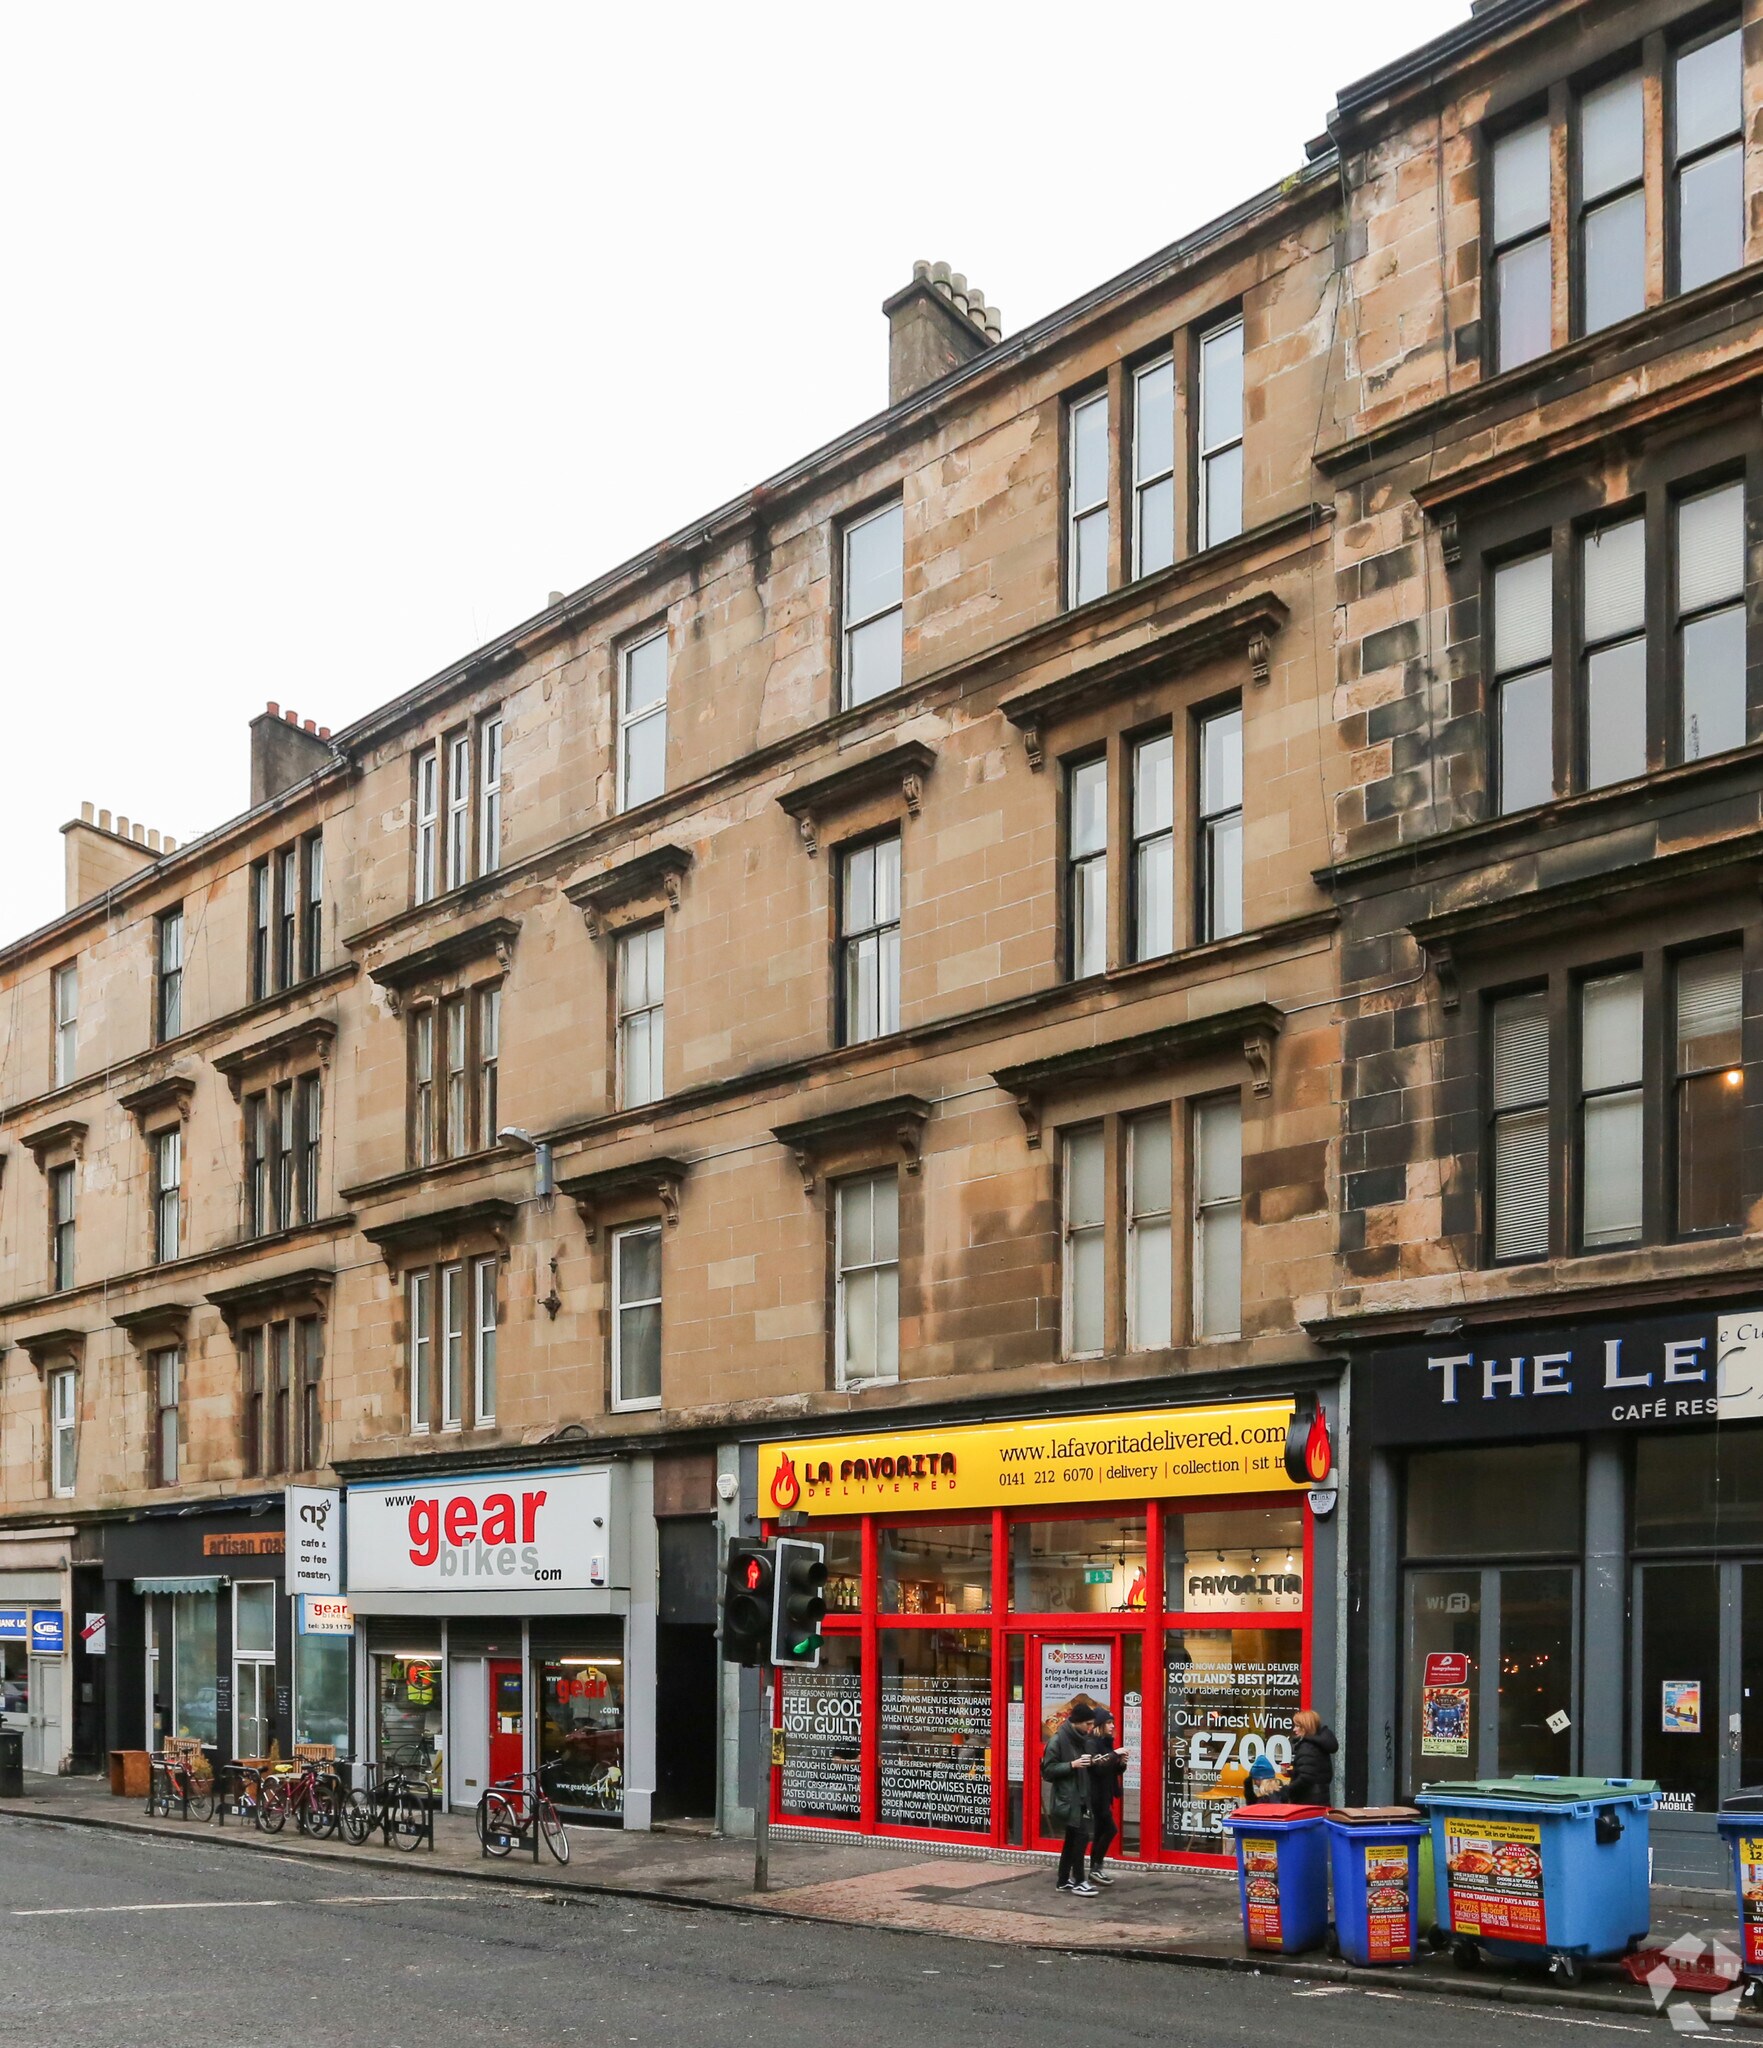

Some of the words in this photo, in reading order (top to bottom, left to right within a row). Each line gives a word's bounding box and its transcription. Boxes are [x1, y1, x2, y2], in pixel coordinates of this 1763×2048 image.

[1428, 1351, 1572, 1403] THE
[1603, 1338, 1706, 1388] LE
[1612, 1398, 1666, 1420] CAFÉ
[1676, 1398, 1718, 1416] RES
[1000, 1425, 1287, 1463] www.lafavoritadelivered.com
[806, 1462, 832, 1485] LA
[840, 1452, 956, 1482] FAVORITA
[1000, 1473, 1024, 1486] 0141
[1034, 1470, 1055, 1484] 212
[1063, 1468, 1094, 1482] 6070
[1106, 1464, 1158, 1481] delivery
[1172, 1459, 1239, 1476] collection
[1252, 1456, 1270, 1470] sit
[808, 1480, 956, 1498] DELIVERED
[385, 1496, 416, 1507] www
[408, 1490, 548, 1566] gear
[210, 1536, 254, 1554] artisan
[302, 1540, 320, 1548] cafe
[300, 1556, 327, 1564] cofee
[440, 1539, 539, 1576] bikes
[534, 1568, 562, 1580] com
[1189, 1574, 1302, 1596] FAVORITA
[1194, 1597, 1300, 1606] LIVERED
[314, 1603, 347, 1616] gear
[0, 1619, 15, 1627] ANK
[1067, 1668, 1082, 1676] large
[1169, 1662, 1194, 1670] ORDER
[1234, 1663, 1246, 1671] WE
[1247, 1663, 1266, 1671] WILL
[1268, 1663, 1299, 1671] DELIVER
[924, 1681, 949, 1689] TWO
[1169, 1672, 1236, 1684] SCOTLAND'S
[1238, 1674, 1265, 1684] BEST
[1266, 1674, 1300, 1685] PIZZA
[557, 1680, 607, 1704] gear
[1169, 1686, 1177, 1694] to
[1178, 1687, 1197, 1696] your
[1199, 1686, 1219, 1695] table
[1221, 1687, 1240, 1696] here
[1251, 1690, 1271, 1698] your
[1273, 1688, 1299, 1698] home
[782, 1698, 814, 1715] FEEL
[816, 1698, 862, 1717] GOOD
[899, 1695, 920, 1703] DRINKS
[922, 1696, 940, 1704] MENU
[949, 1697, 991, 1705] RESTAURANT
[782, 1715, 813, 1733] NOT
[814, 1716, 862, 1735] GUILTY
[882, 1716, 902, 1724] WHEN
[915, 1717, 927, 1725] SAY
[927, 1717, 944, 1725] £7.00
[945, 1718, 959, 1726] FOR
[966, 1718, 991, 1727] BOTTLE
[1175, 1710, 1202, 1726] Our
[1207, 1711, 1250, 1728] Finest
[1253, 1712, 1292, 1730] Wine
[1552, 1718, 1563, 1727] 41
[812, 1749, 833, 1757] ONE
[916, 1747, 955, 1756] THREE
[1172, 1736, 1188, 1768] only
[1188, 1732, 1292, 1774] £7.00
[882, 1768, 901, 1776] USING
[902, 1769, 919, 1778] ONLY
[920, 1770, 932, 1778] THE
[933, 1771, 948, 1779] BEST
[949, 1772, 991, 1782] INGREDIENTS
[1194, 1770, 1222, 1782] bottle
[882, 1777, 895, 1788] NO
[897, 1778, 964, 1793] COMPROMISES
[967, 1782, 991, 1794] EVER!
[882, 1789, 891, 1797] SO
[892, 1790, 912, 1798] WHAT
[912, 1791, 926, 1799] ARE
[927, 1792, 941, 1800] YOU
[943, 1793, 972, 1803] WAITING
[973, 1795, 991, 1804] FOR?
[882, 1799, 903, 1808] ORDER
[905, 1801, 923, 1810] NOW
[925, 1802, 936, 1811] AND
[938, 1803, 960, 1813] ENJOY
[960, 1805, 973, 1814] THE
[974, 1806, 991, 1815] BEST
[1172, 1798, 1206, 1810] Moretti
[1209, 1800, 1237, 1814] Lager
[1660, 1802, 1693, 1811] MOBILE
[892, 1810, 915, 1819] EATING
[916, 1812, 931, 1821] OUT
[932, 1813, 953, 1822] WHEN
[954, 1815, 969, 1824] YOU
[970, 1816, 982, 1825] EAT
[984, 1817, 991, 1825] IN
[1172, 1810, 1182, 1830] only
